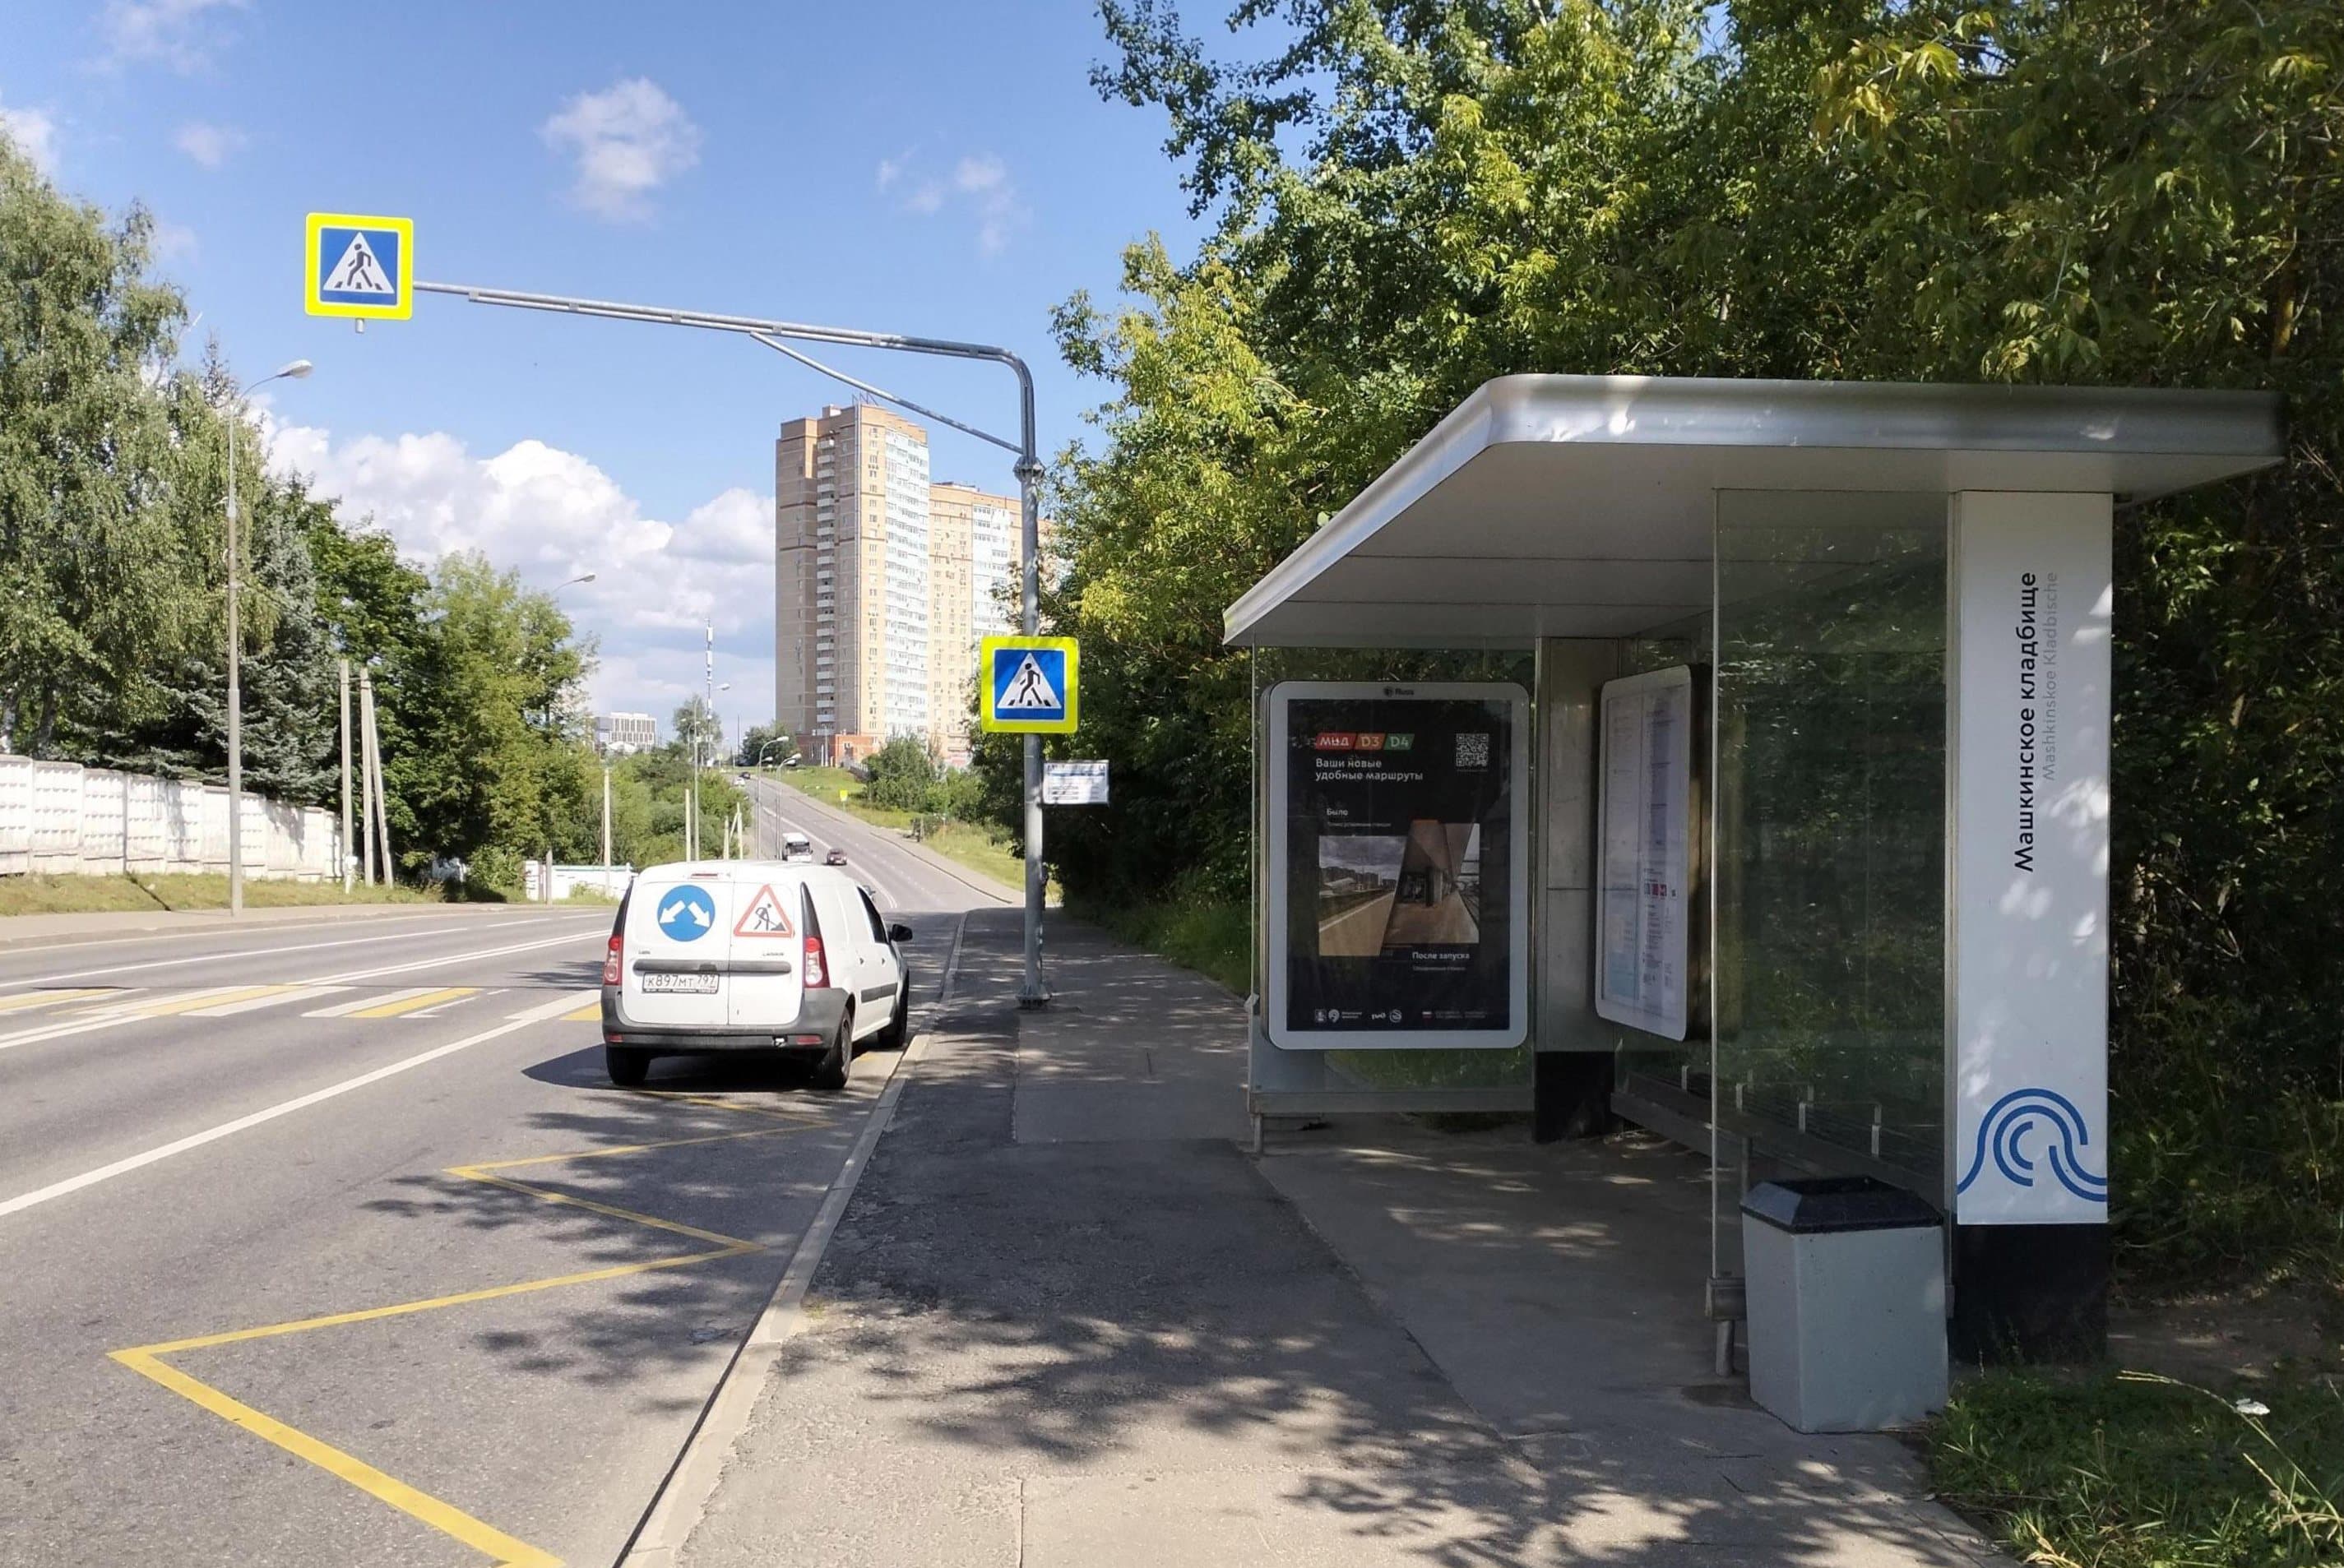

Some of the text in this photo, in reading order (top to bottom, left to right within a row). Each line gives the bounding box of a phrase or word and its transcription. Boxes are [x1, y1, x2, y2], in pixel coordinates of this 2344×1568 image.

[2042, 572, 2057, 780] Mashkinskoe Kladbische
[2014, 572, 2039, 872] Машкинское кладбище
[1360, 736, 1379, 747] D3
[1391, 736, 1409, 747] D4
[1316, 758, 1382, 768] Ваши новые
[1316, 770, 1423, 782] удобные маршруты
[1412, 951, 1437, 960] После
